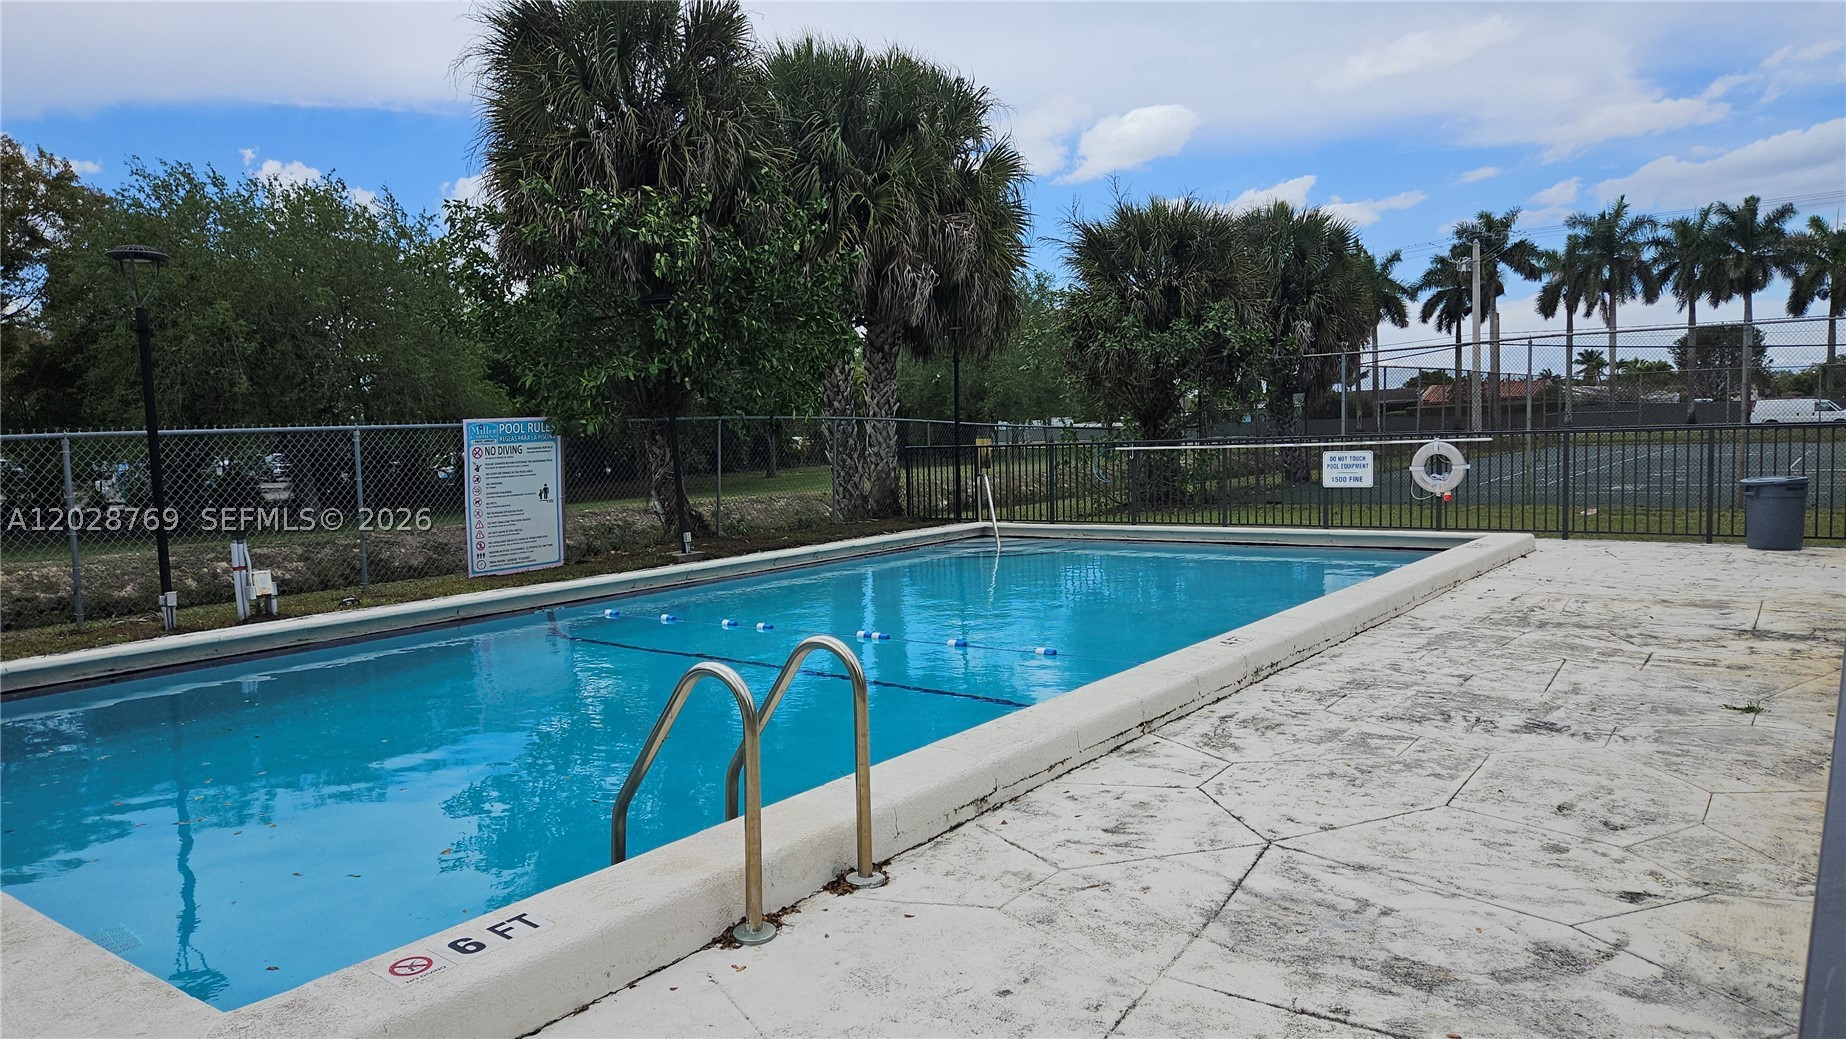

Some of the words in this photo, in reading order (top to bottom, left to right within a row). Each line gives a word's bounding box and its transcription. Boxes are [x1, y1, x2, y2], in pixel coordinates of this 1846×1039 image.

[470, 424, 497, 435] Miller
[499, 423, 525, 434] POOL
[518, 434, 531, 442] PARA
[485, 446, 496, 456] NO
[498, 445, 523, 455] DIVING
[447, 937, 487, 955] 6
[486, 912, 541, 941] FT
